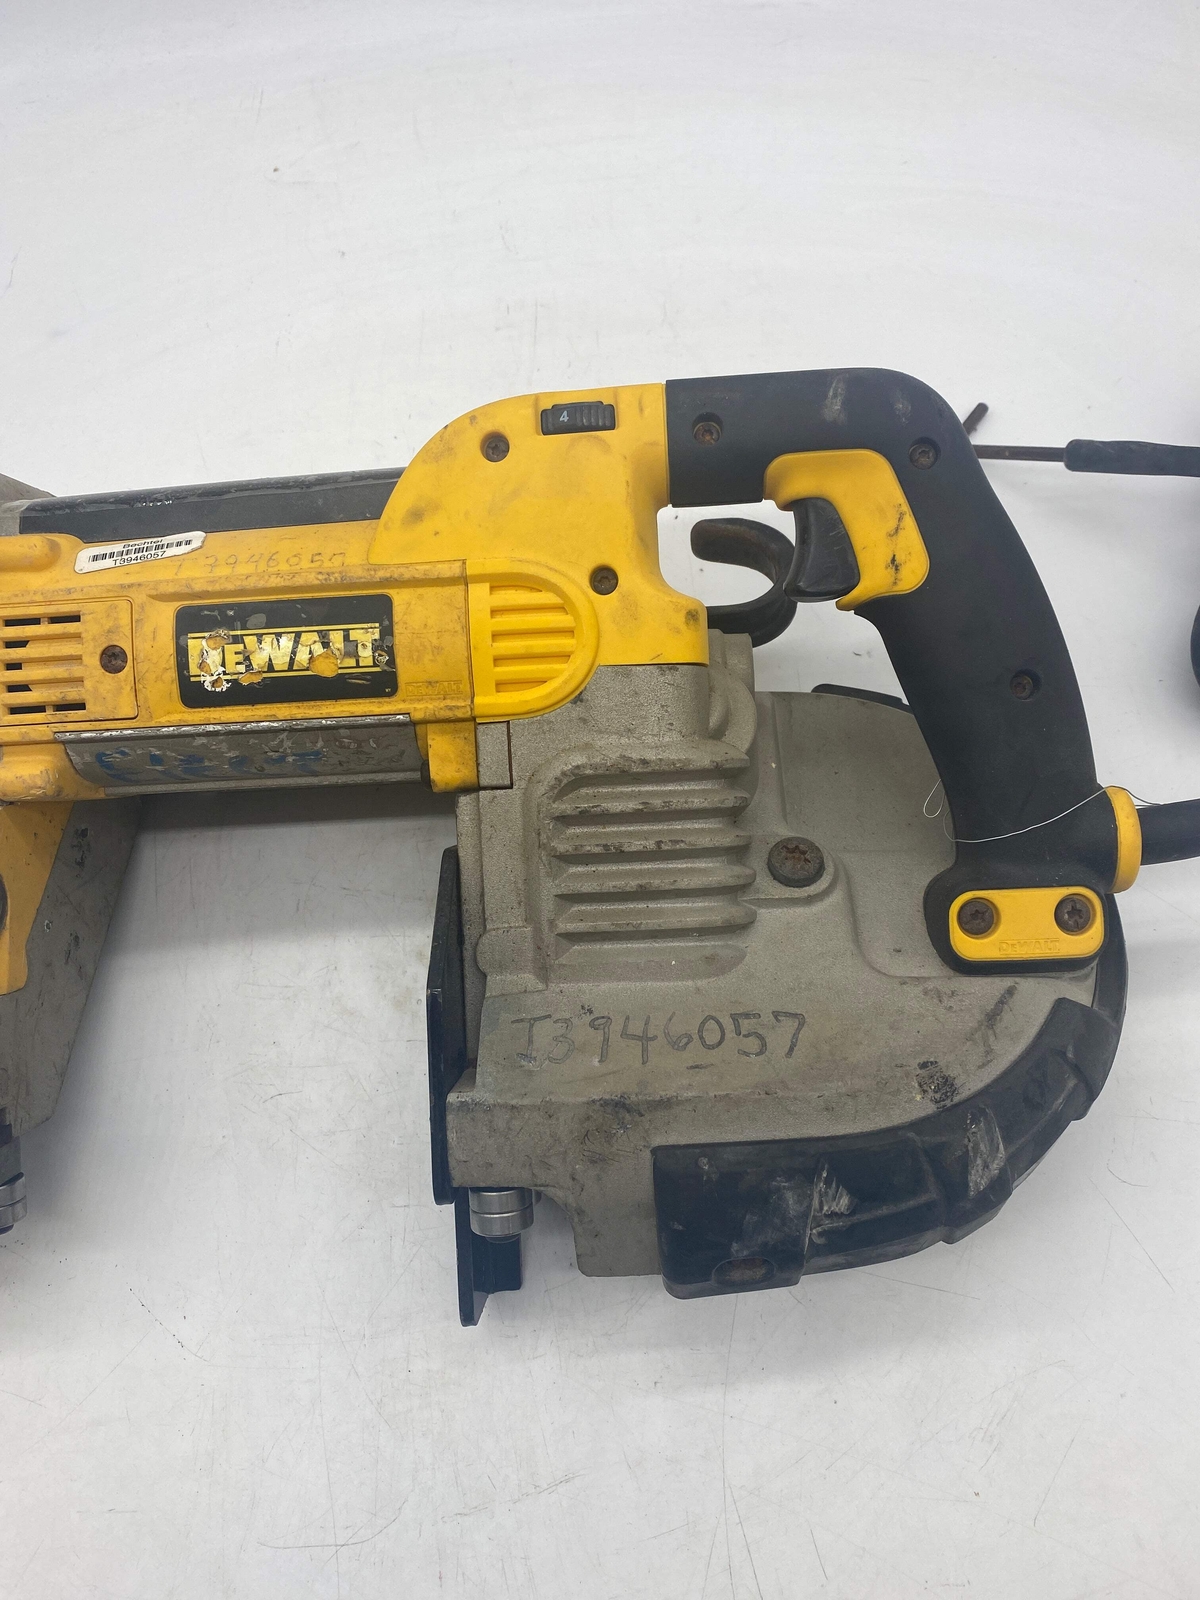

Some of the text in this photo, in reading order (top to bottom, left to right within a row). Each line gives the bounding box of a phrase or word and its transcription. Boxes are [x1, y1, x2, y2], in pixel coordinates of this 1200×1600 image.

[559, 410, 569, 422] 4
[122, 539, 163, 549] Bechtel
[112, 551, 167, 566] T3946057
